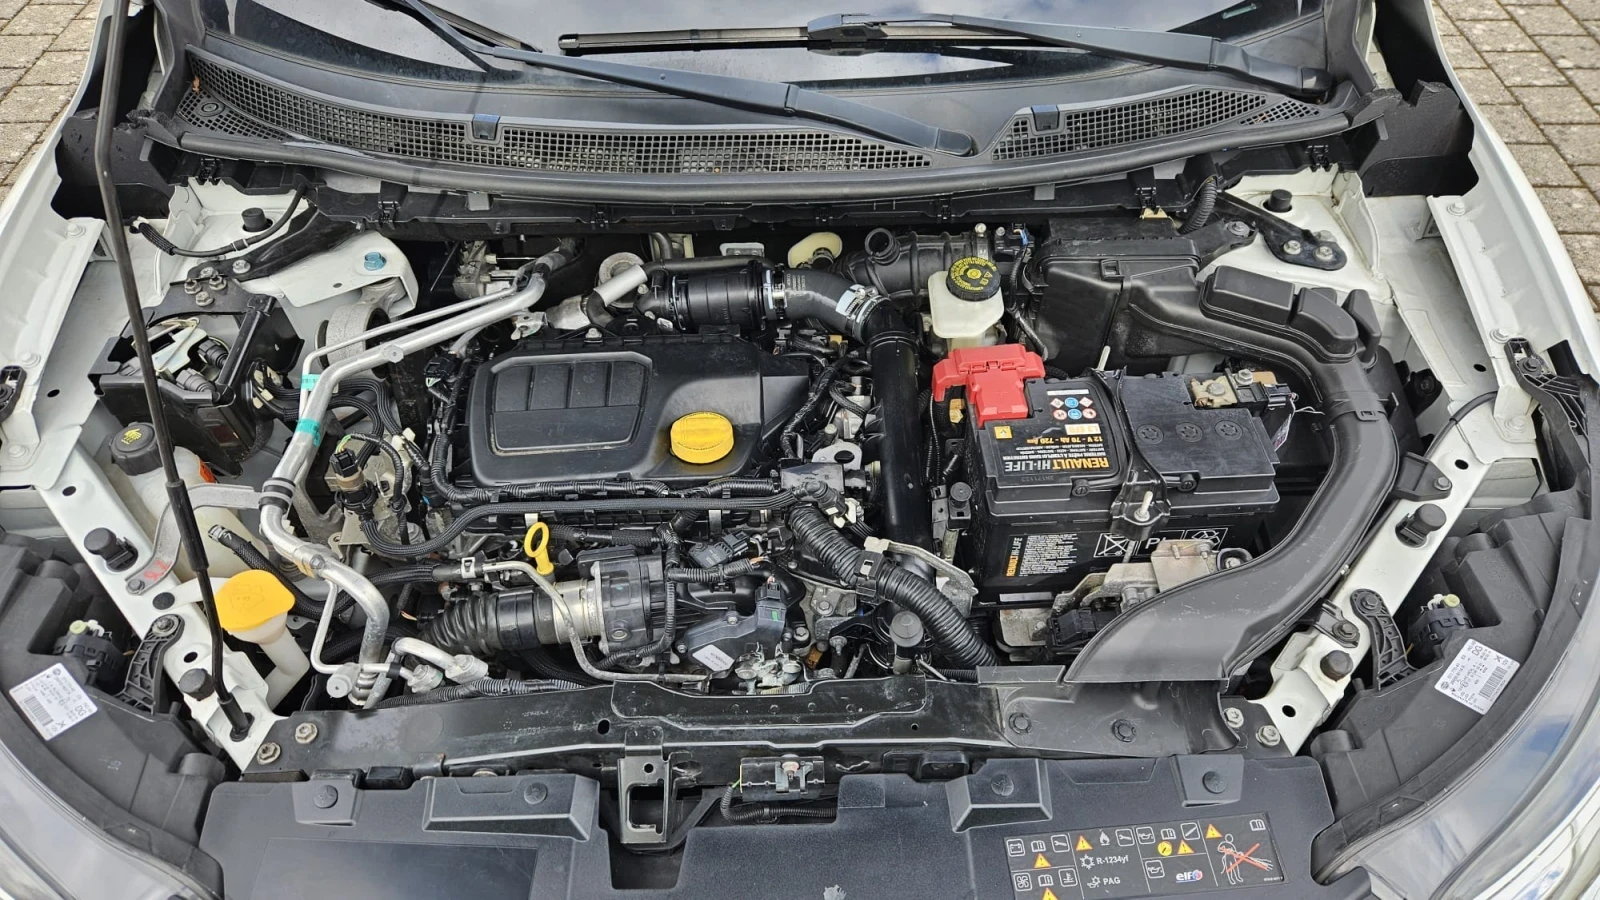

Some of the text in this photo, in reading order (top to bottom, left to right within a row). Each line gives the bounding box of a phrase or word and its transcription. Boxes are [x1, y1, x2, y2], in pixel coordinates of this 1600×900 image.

[1052, 457, 1109, 470] RENAULT
[1006, 555, 1019, 577] RENAULT
[1471, 645, 1483, 656] DG
[1096, 855, 1129, 865] R-1234yf
[1102, 877, 1121, 885] PAG
